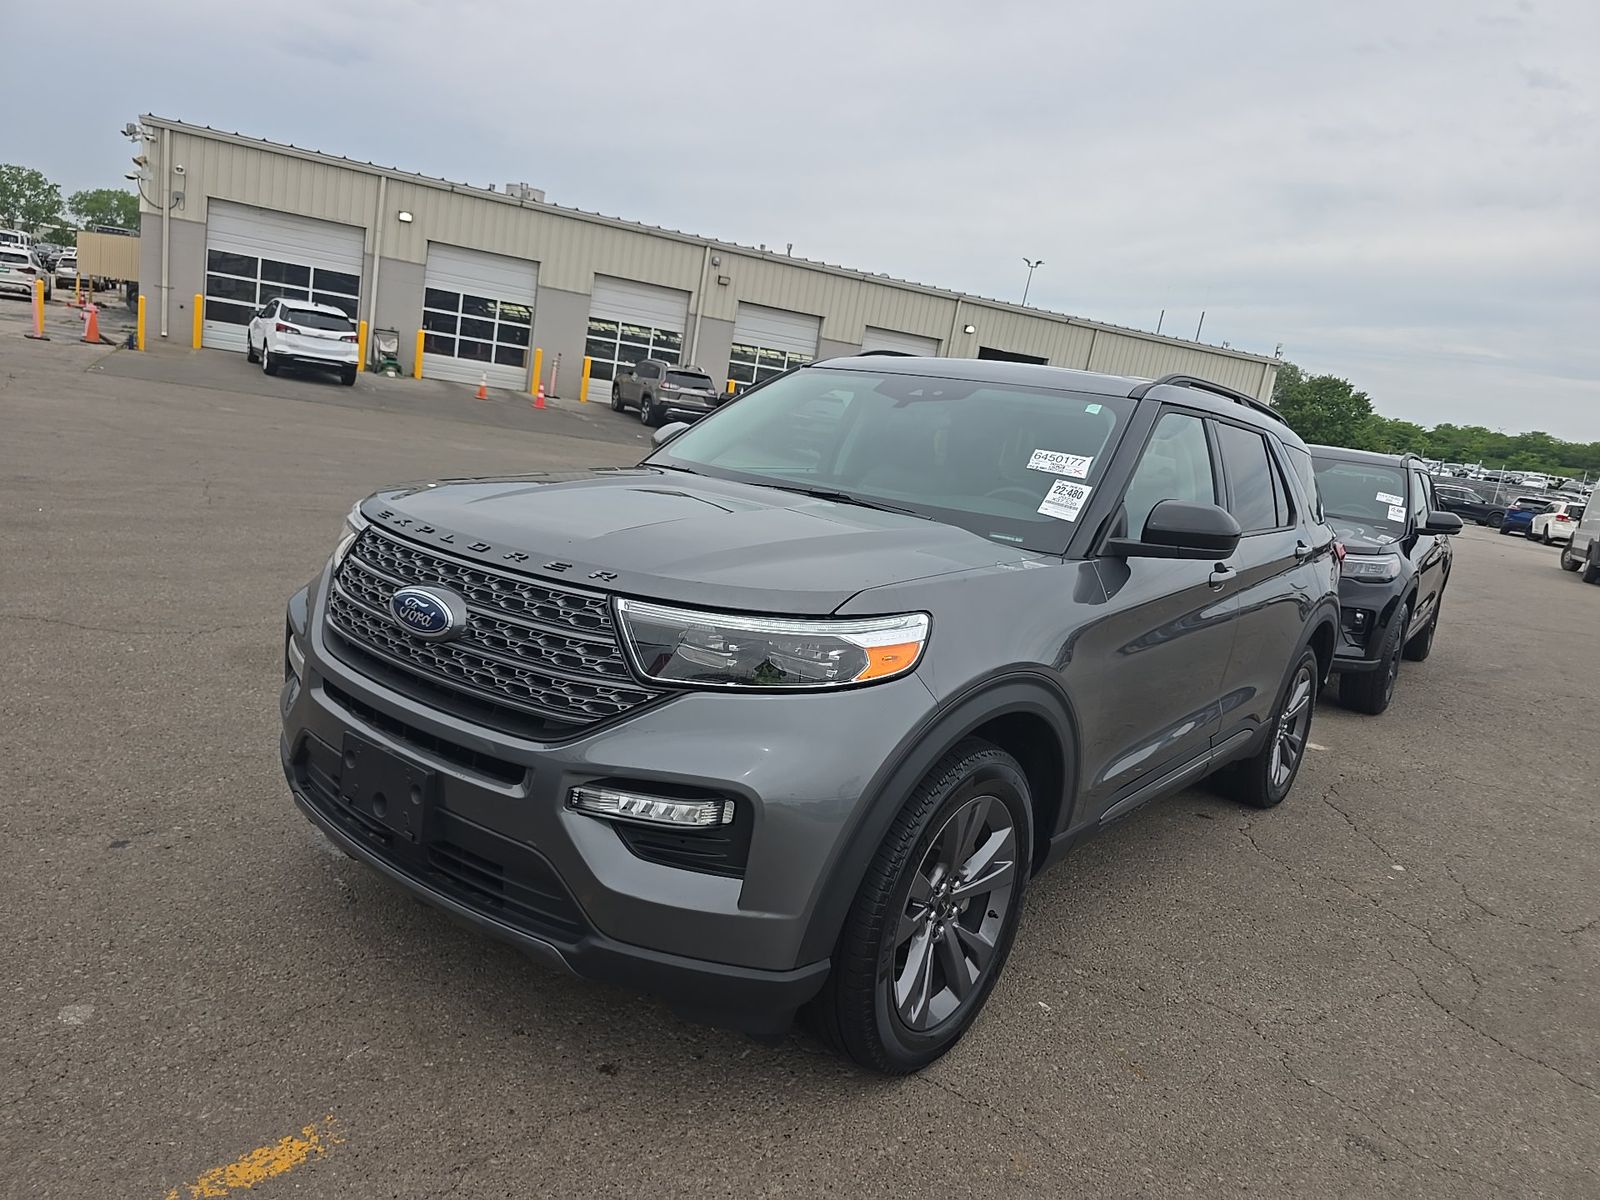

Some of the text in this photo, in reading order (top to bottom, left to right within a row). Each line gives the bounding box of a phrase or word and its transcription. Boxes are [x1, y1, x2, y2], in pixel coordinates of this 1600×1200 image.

[1034, 452, 1086, 467] 6450177
[377, 510, 618, 582] EXPLORER
[400, 597, 435, 628] Ford
